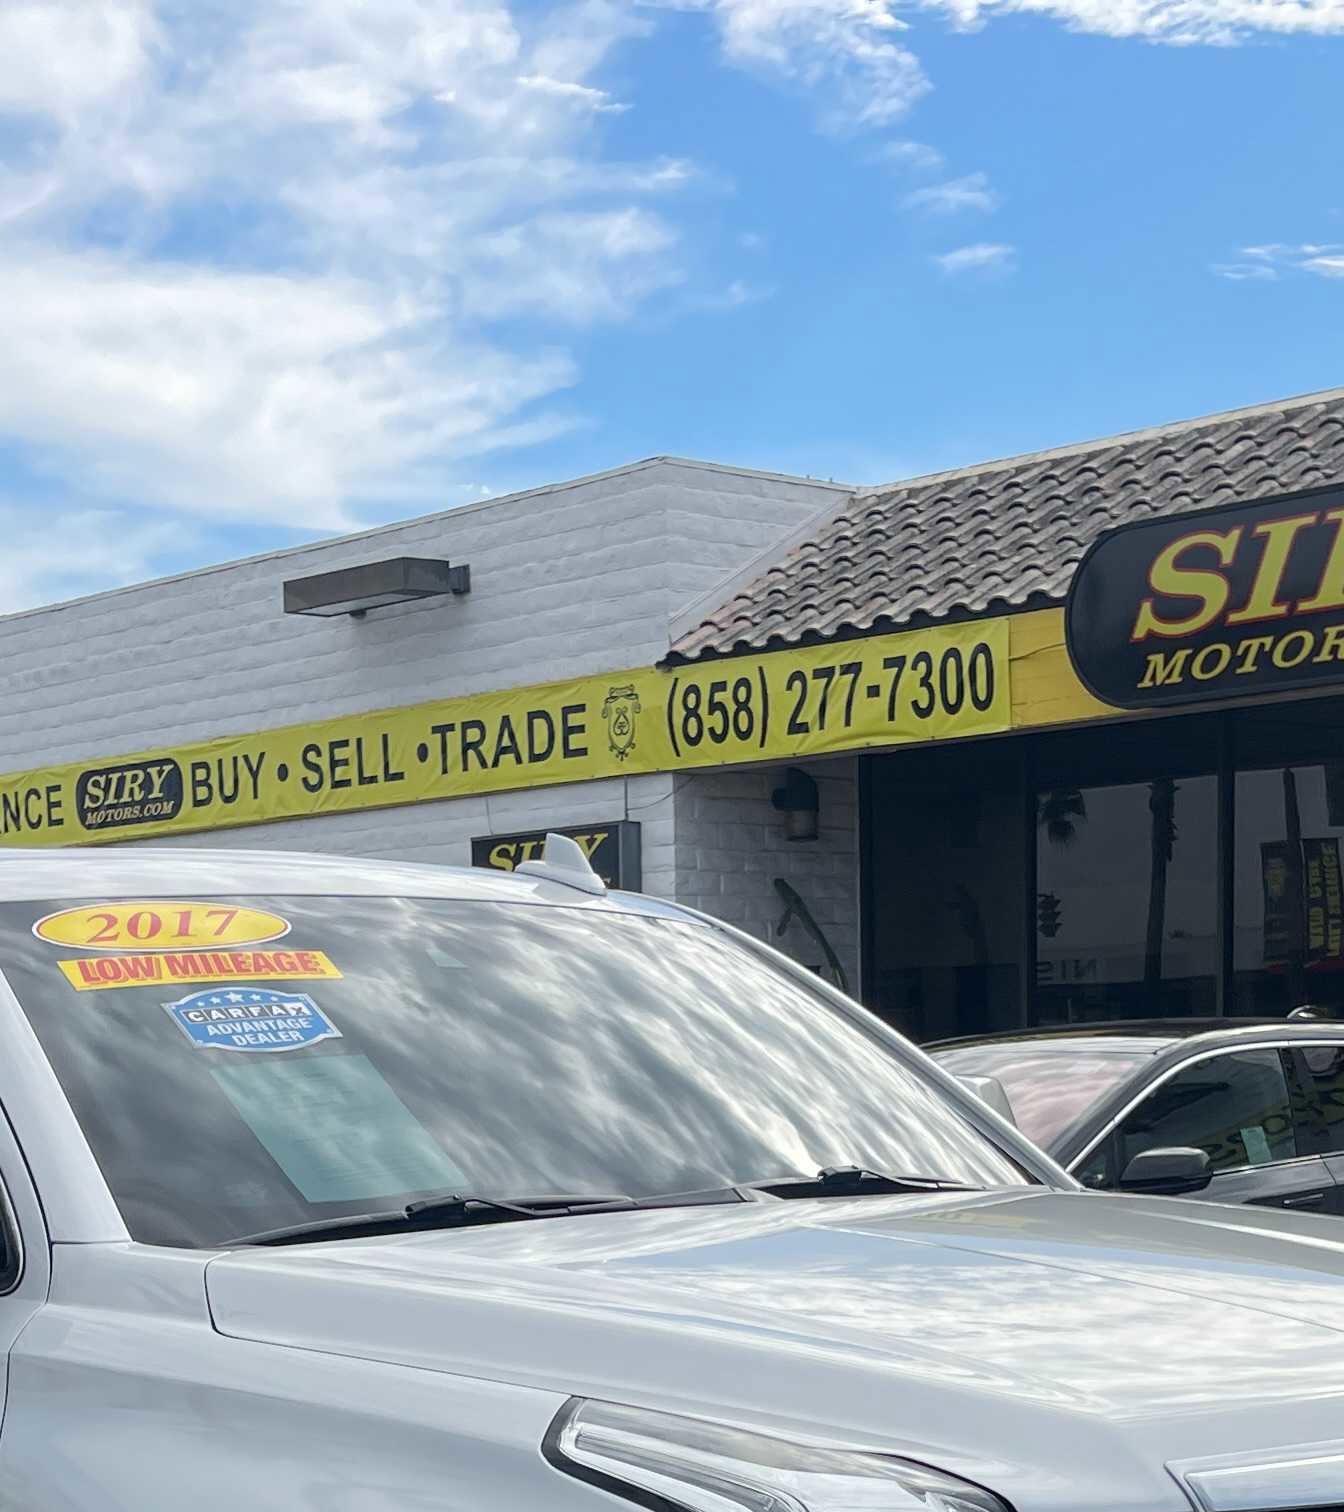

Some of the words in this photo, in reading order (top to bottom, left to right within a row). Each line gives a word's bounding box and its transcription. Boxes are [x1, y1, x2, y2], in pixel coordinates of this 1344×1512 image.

[666, 665, 770, 758] (858)
[786, 641, 996, 737] 277-7300
[191, 752, 266, 808] BUY
[301, 733, 406, 794] SELL
[431, 704, 588, 777] TRADE
[83, 764, 175, 809] SIRY
[85, 801, 175, 826] MOTORS.COM
[86, 909, 239, 944] 2017
[77, 955, 162, 985] LOW
[164, 951, 325, 978] MILEAGE
[186, 1002, 311, 1023] CARFAX
[207, 1017, 312, 1036] ADVANTAGE
[232, 1031, 305, 1047] DEALER
